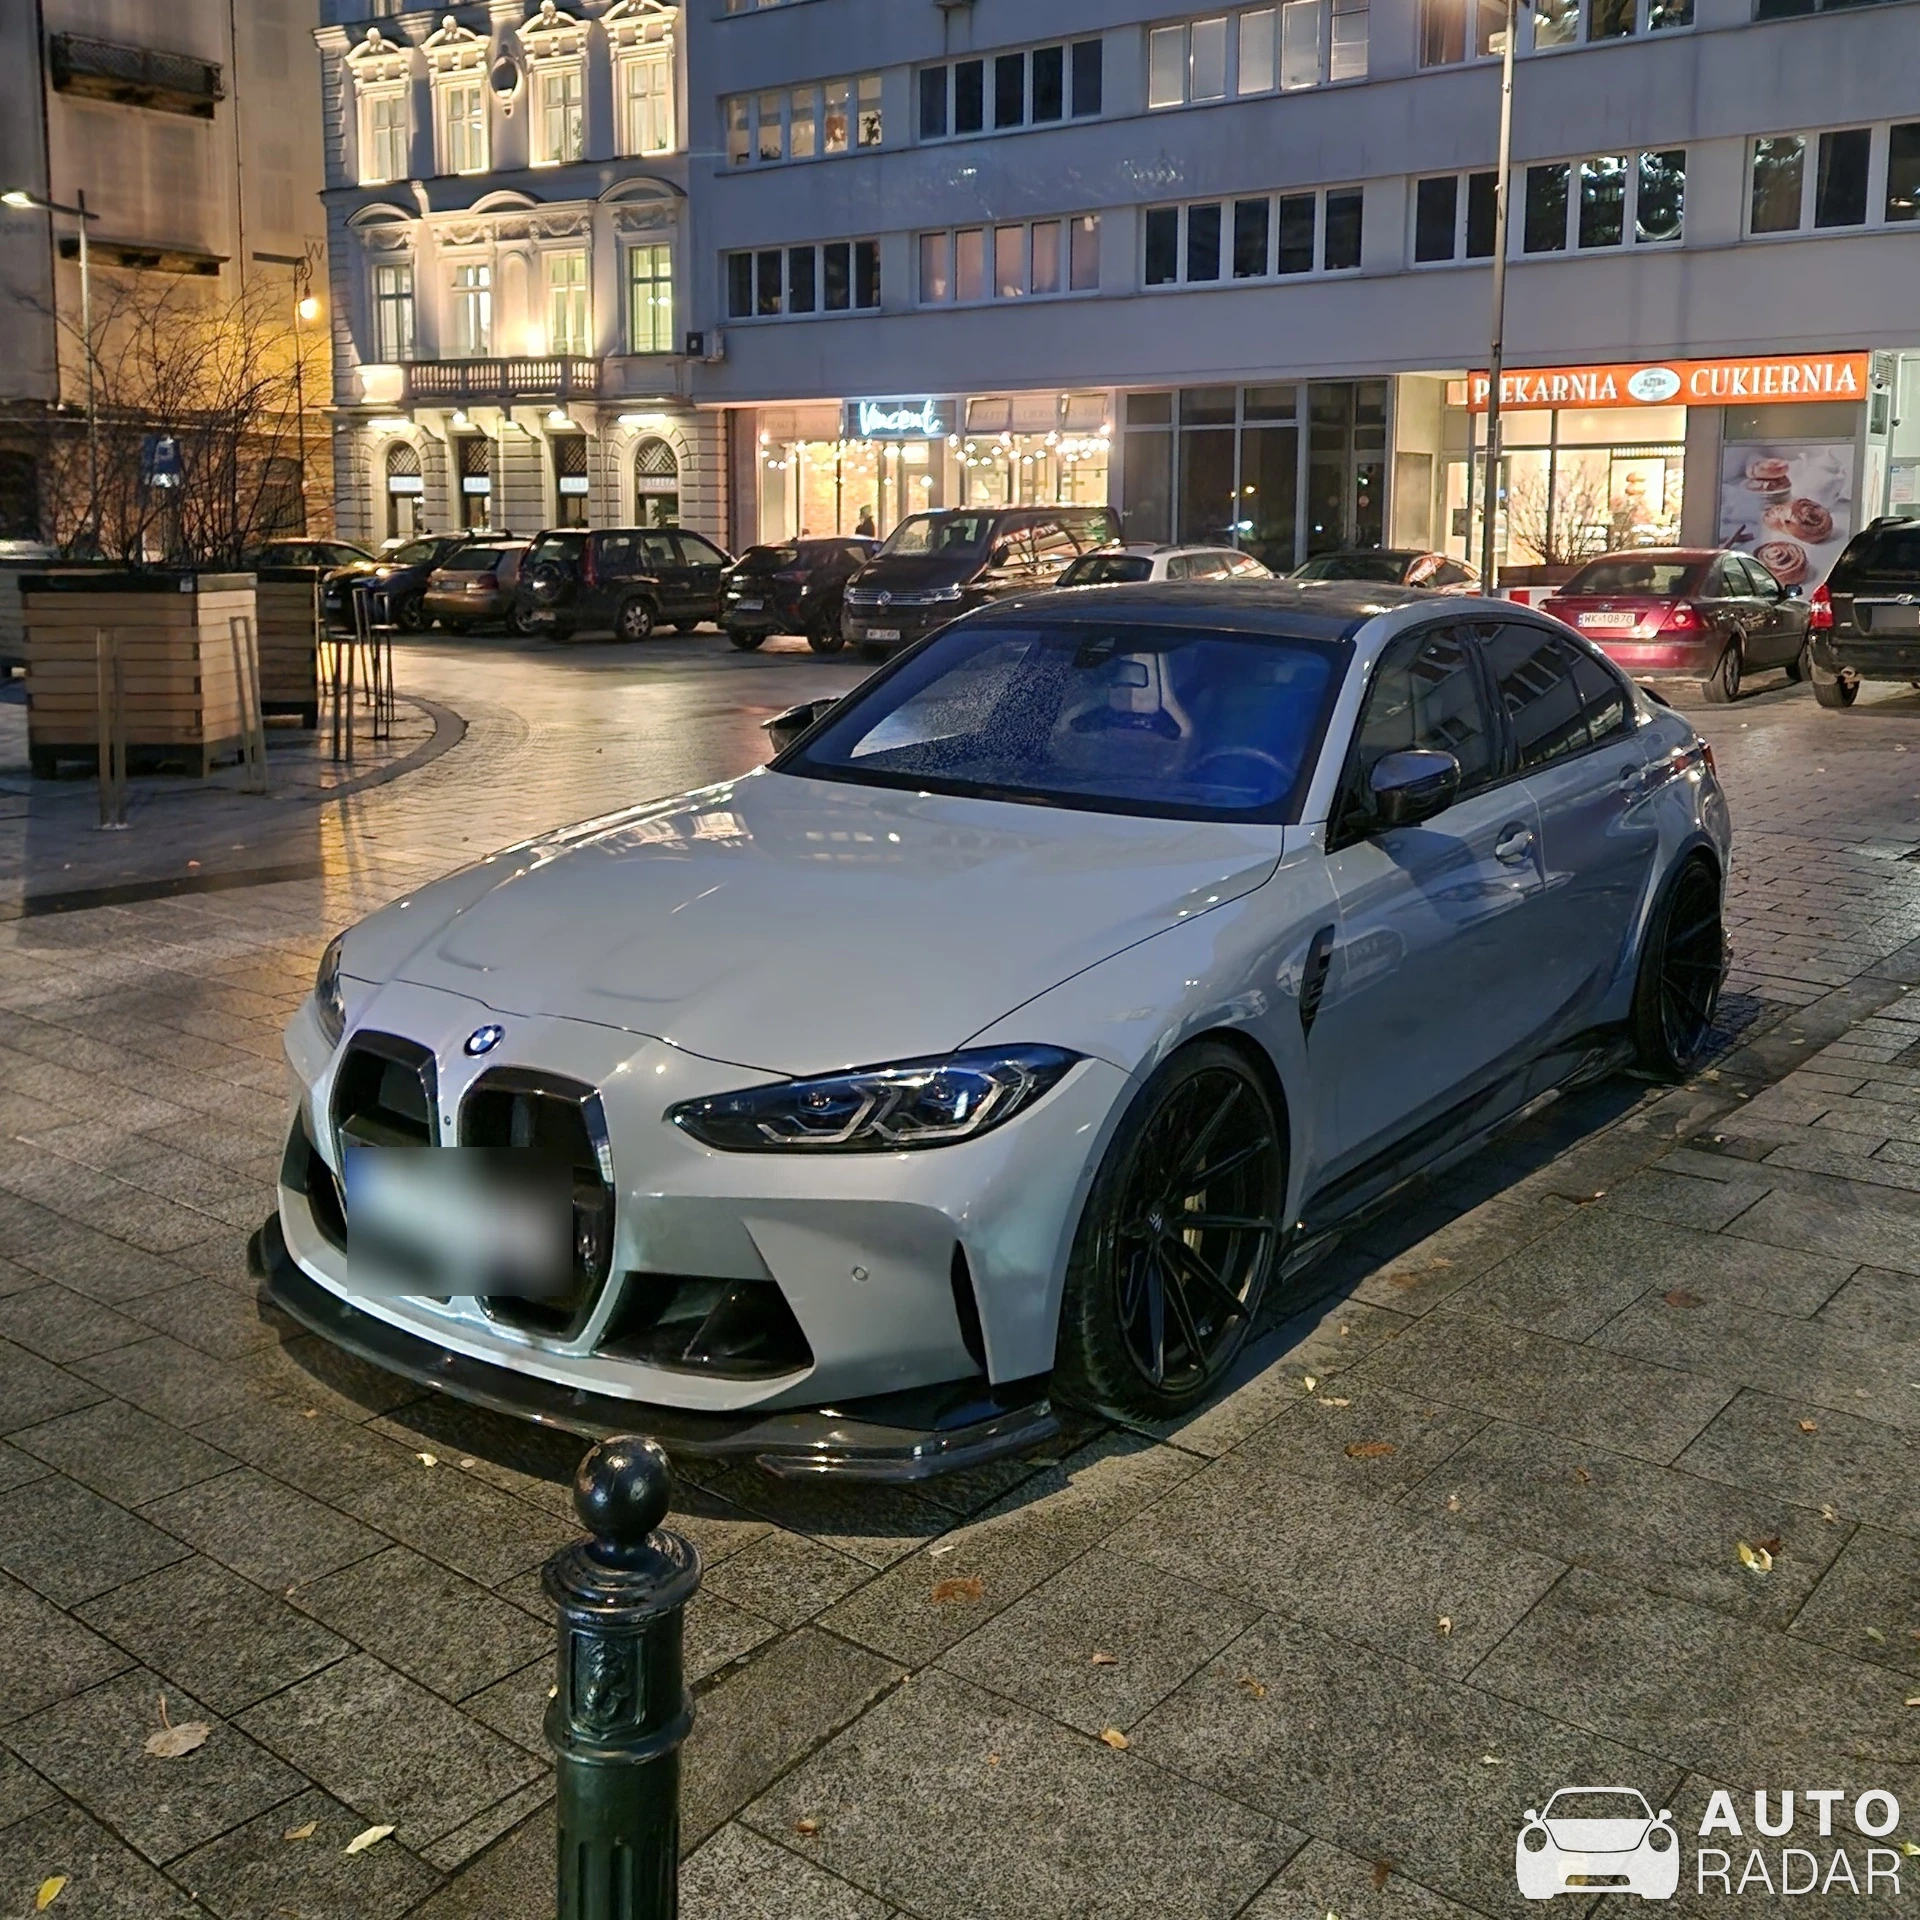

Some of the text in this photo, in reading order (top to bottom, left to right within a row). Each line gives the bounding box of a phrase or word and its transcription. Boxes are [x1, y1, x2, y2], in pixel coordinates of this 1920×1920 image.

[1474, 373, 1618, 404] PEKARNIA
[1690, 363, 1858, 397] CUKIERNIA
[859, 399, 942, 435] Vincent
[1584, 614, 1633, 625] WK 10870
